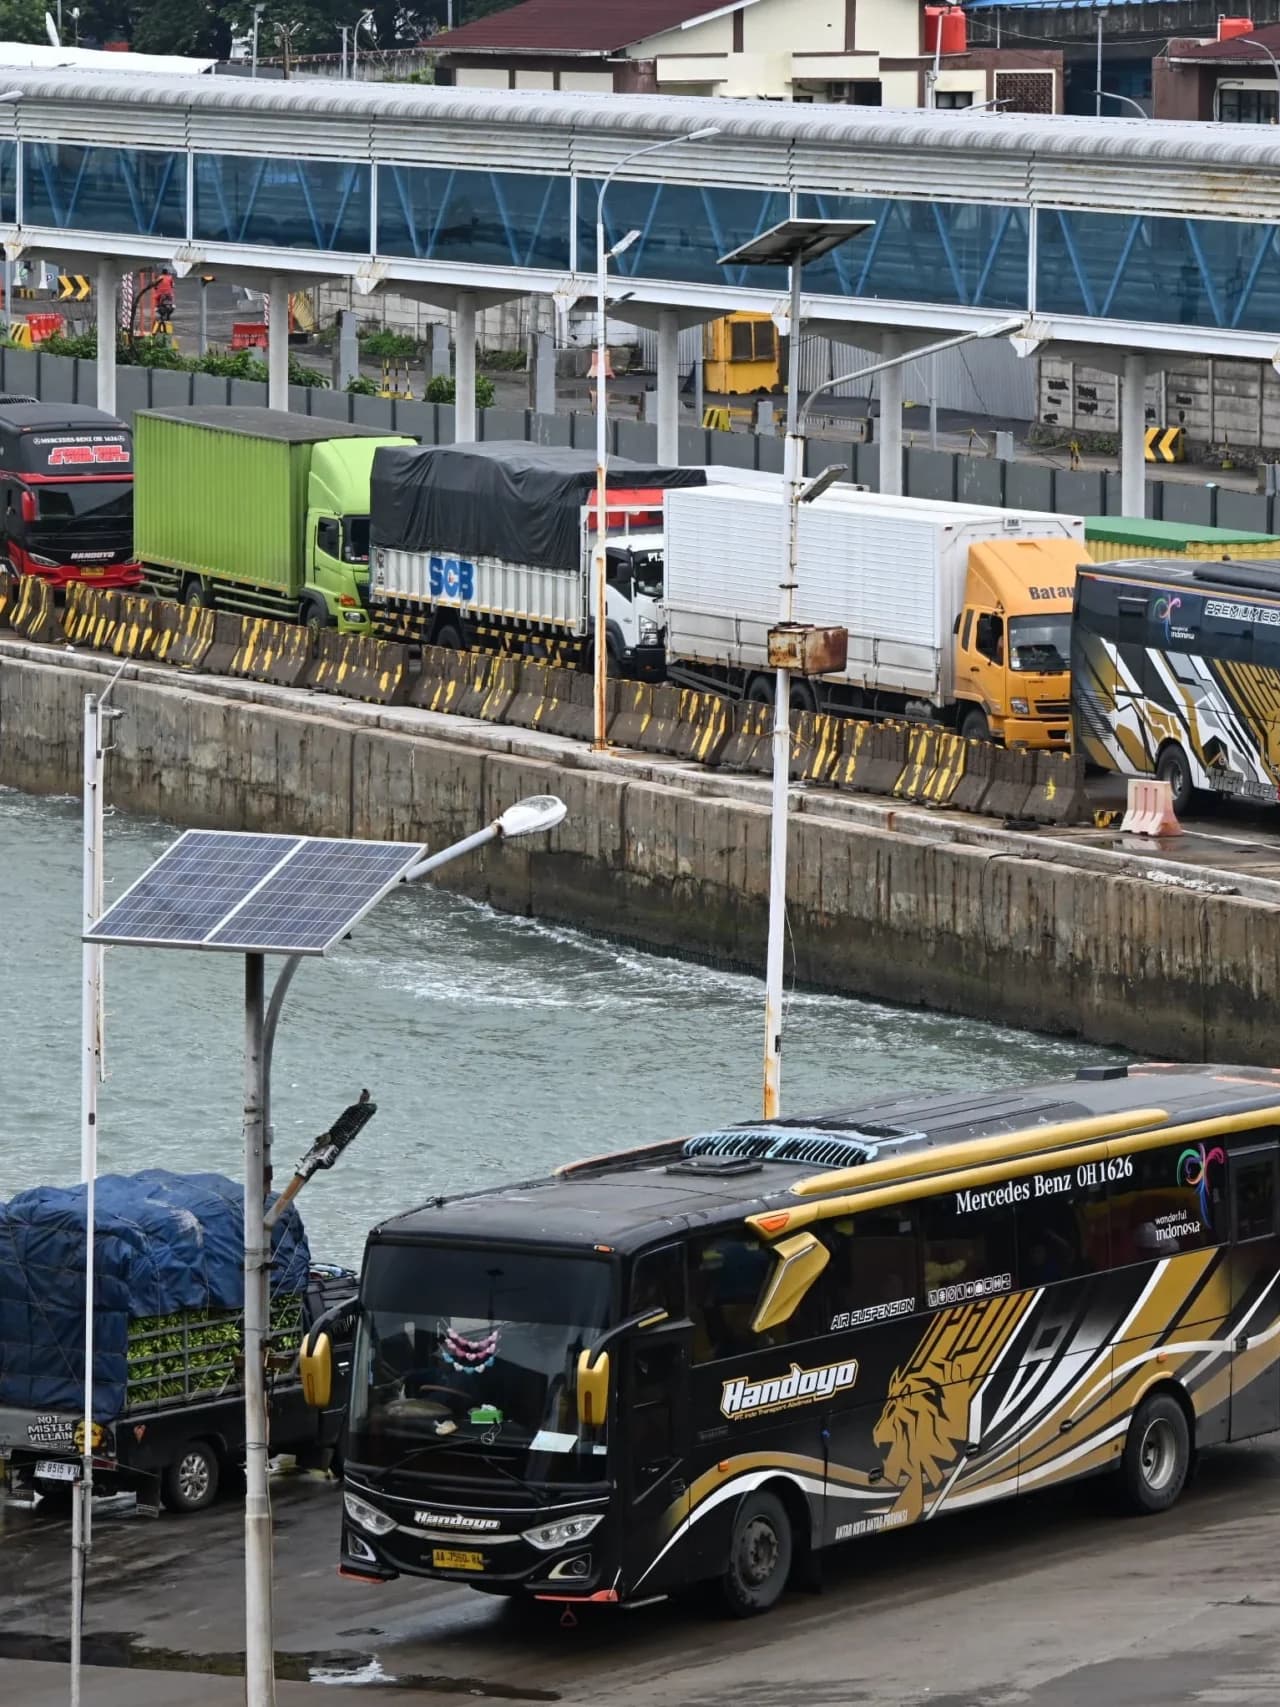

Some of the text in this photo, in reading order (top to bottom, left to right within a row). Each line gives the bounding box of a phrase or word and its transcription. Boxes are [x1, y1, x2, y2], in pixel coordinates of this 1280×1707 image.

[70, 552, 115, 560] HANDOYO
[430, 556, 474, 600] SCB
[1206, 602, 1261, 622] PREMIUM
[956, 1155, 1133, 1214] Mercedes Benz OH 1626
[1154, 1209, 1188, 1225] wonderful
[1155, 1220, 1201, 1241] indonesia
[830, 1298, 916, 1330] AIR SUSPENSION
[722, 1362, 857, 1415] Handoyo
[27, 1423, 72, 1434] MISTER
[36, 1415, 60, 1424] NOT
[28, 1432, 73, 1441] VILLAIN
[414, 1510, 500, 1530] Handoyo
[835, 1524, 852, 1540] ANTAR
